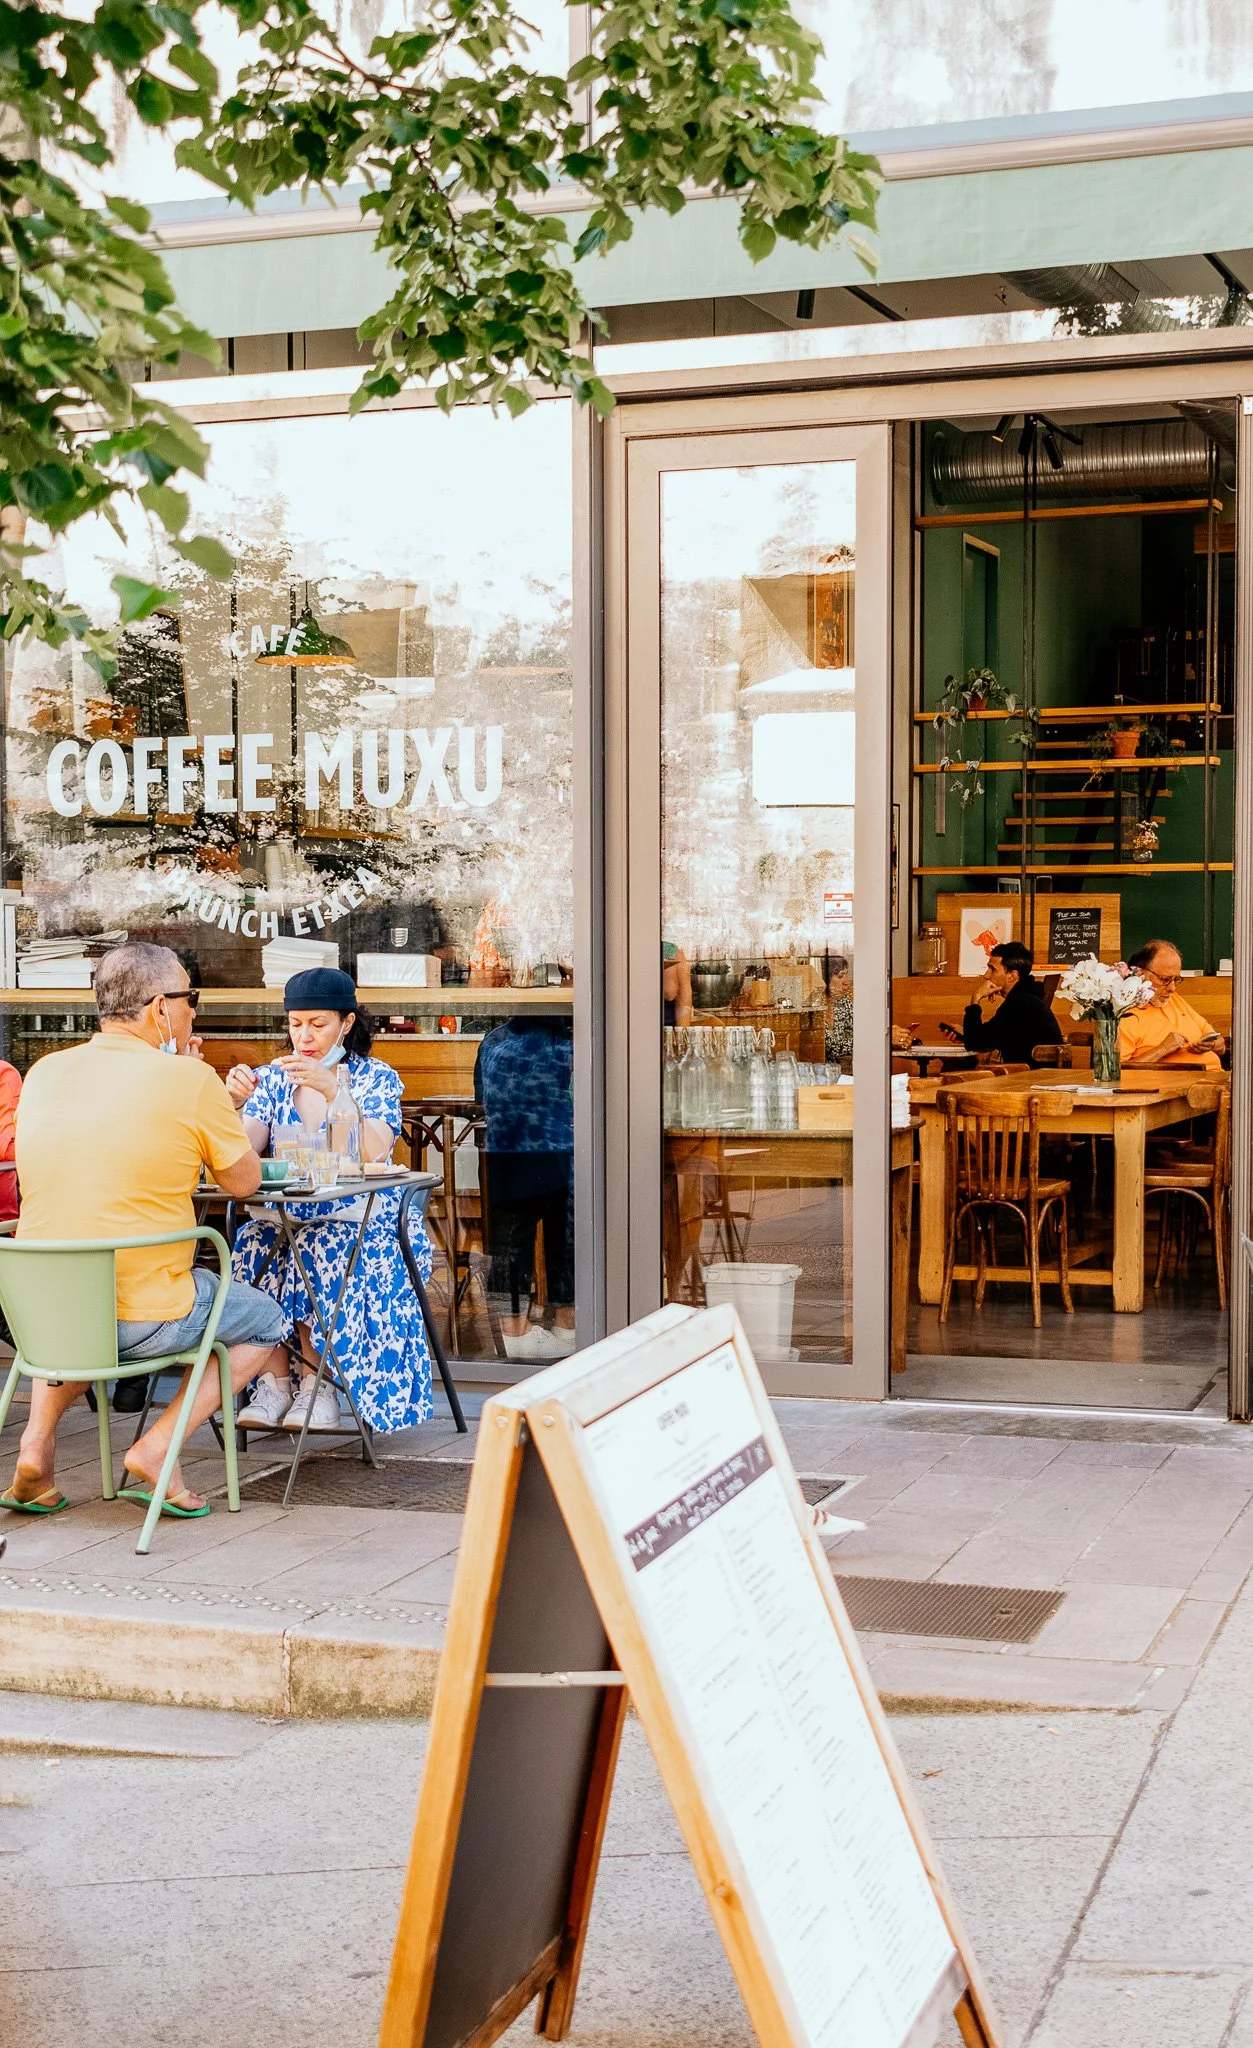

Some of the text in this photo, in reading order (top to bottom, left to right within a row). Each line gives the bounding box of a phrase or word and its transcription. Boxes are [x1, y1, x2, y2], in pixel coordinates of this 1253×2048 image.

[229, 622, 307, 658] CAFÉ
[46, 724, 502, 818] COFFEE MUXU
[161, 865, 382, 939] BRUNCH ETXEA
